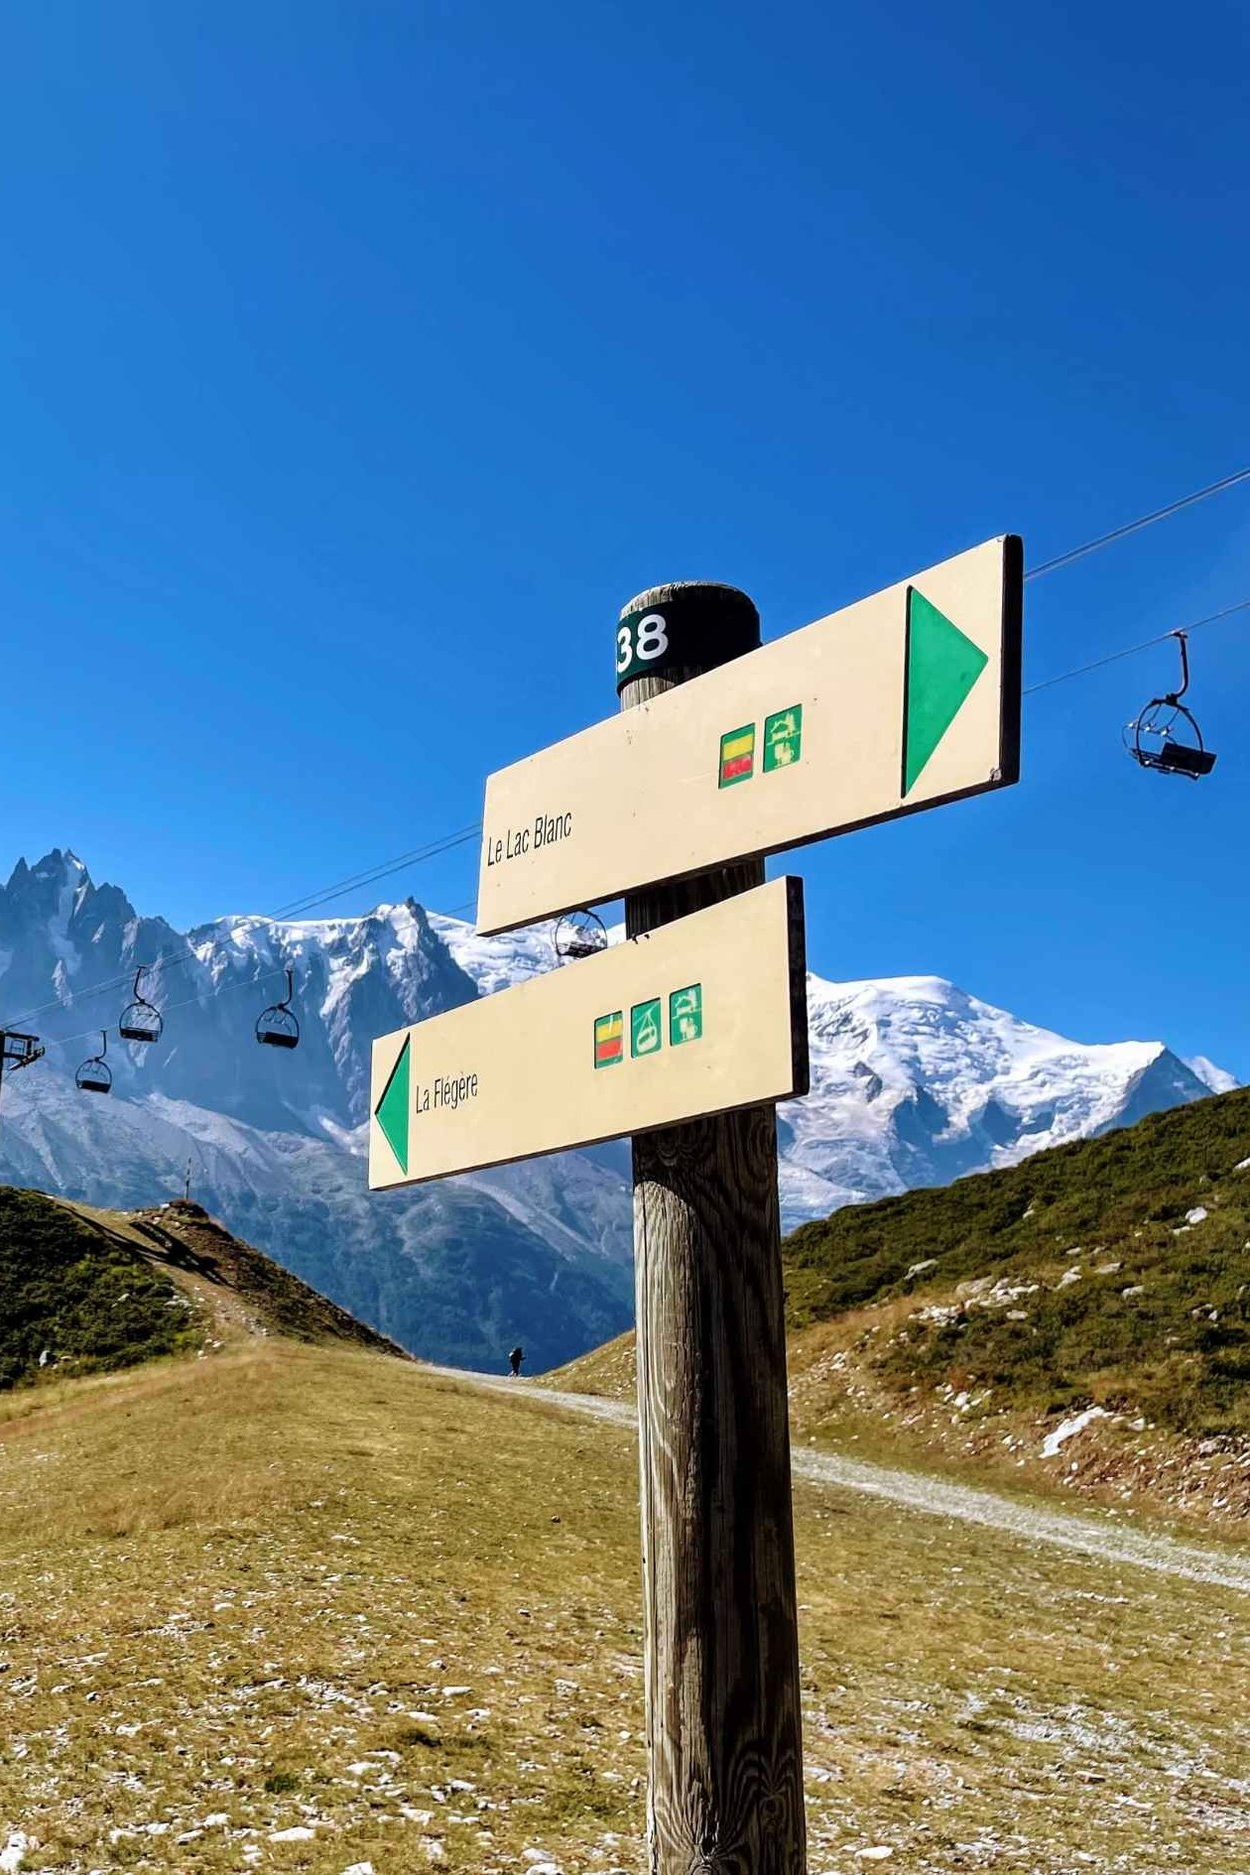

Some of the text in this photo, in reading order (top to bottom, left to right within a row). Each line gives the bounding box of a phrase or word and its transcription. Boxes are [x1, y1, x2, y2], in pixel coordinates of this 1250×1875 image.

[617, 614, 668, 673] 38
[488, 812, 572, 867] Le Lac Blanc
[416, 1085, 430, 1114] La
